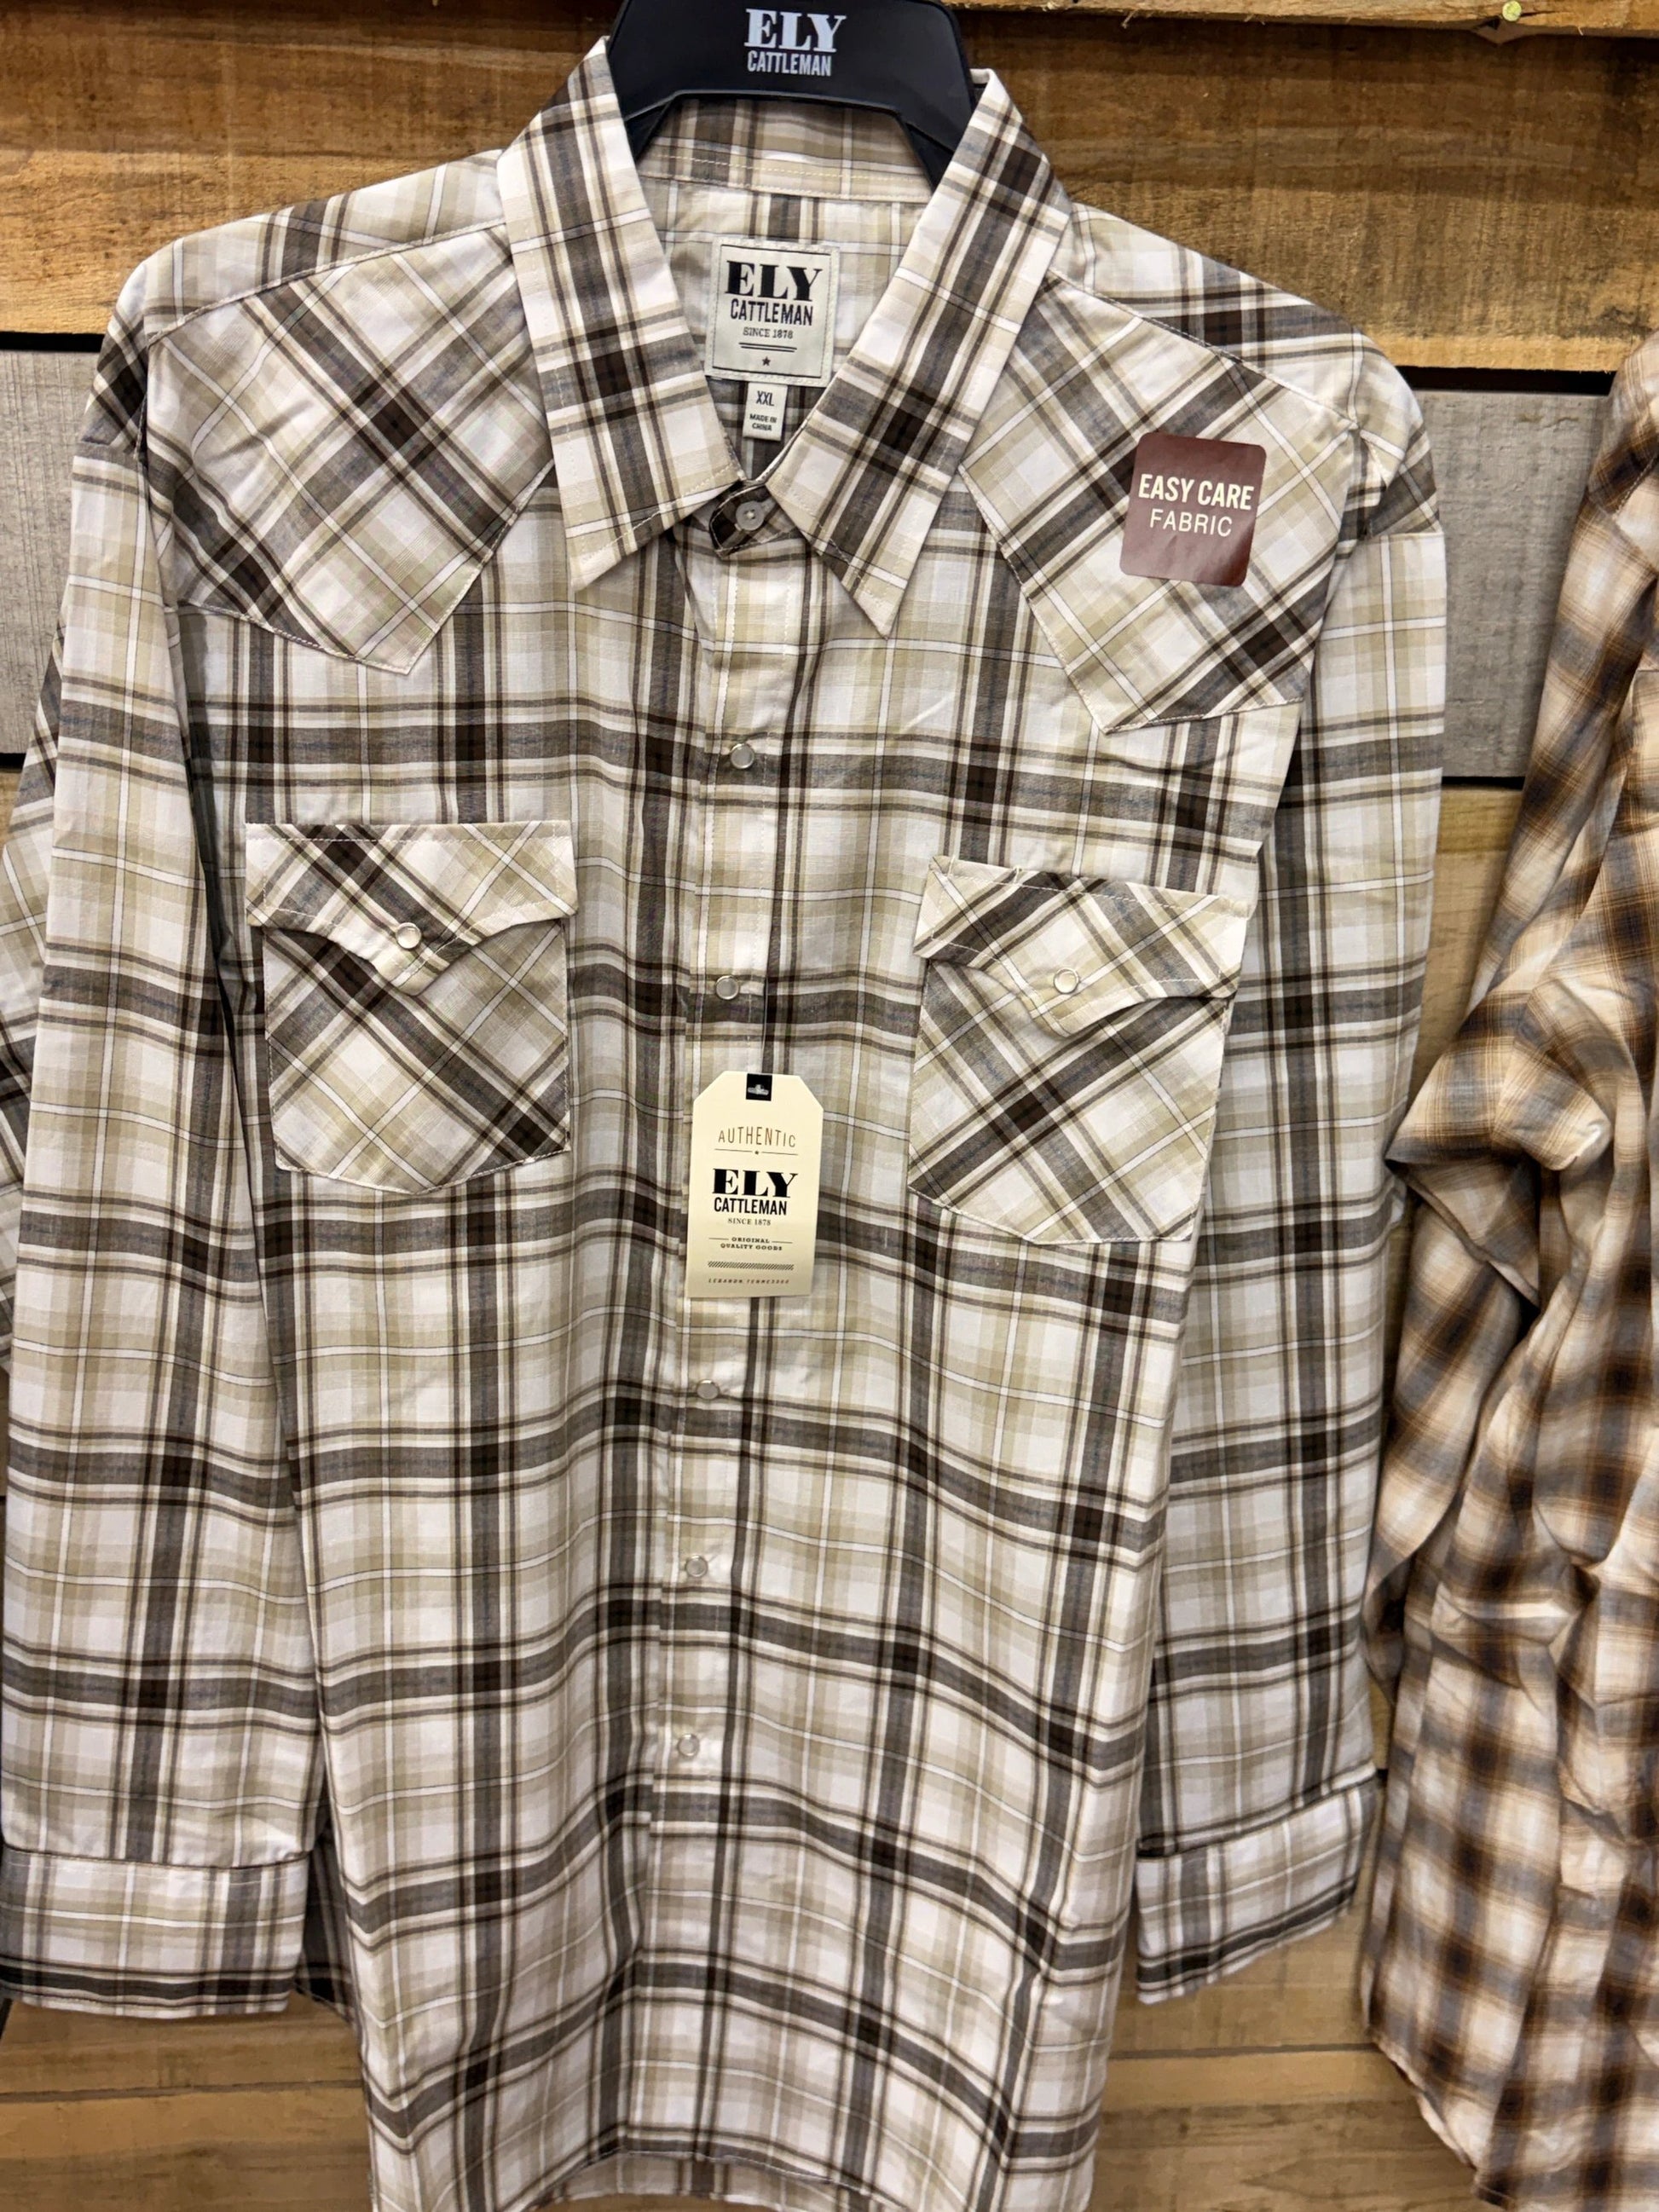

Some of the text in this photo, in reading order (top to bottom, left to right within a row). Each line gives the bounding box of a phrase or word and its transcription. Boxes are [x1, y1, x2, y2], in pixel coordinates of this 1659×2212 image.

[744, 9, 847, 53] ELY
[748, 50, 832, 77] CATTLEMAN
[725, 260, 823, 302] ELY
[730, 298, 813, 326] CATTLEMAN
[743, 326, 794, 339] SINCE 1878
[756, 390, 774, 407] XXL
[749, 413, 770, 423] MADE
[752, 423, 772, 431] CHINA
[1138, 473, 1254, 510] EASY CARE
[1150, 508, 1232, 537] FABRIC
[718, 1126, 796, 1147] AUTHENTIC
[712, 1168, 798, 1198] ELY
[714, 1197, 787, 1216] CATTLEMAN
